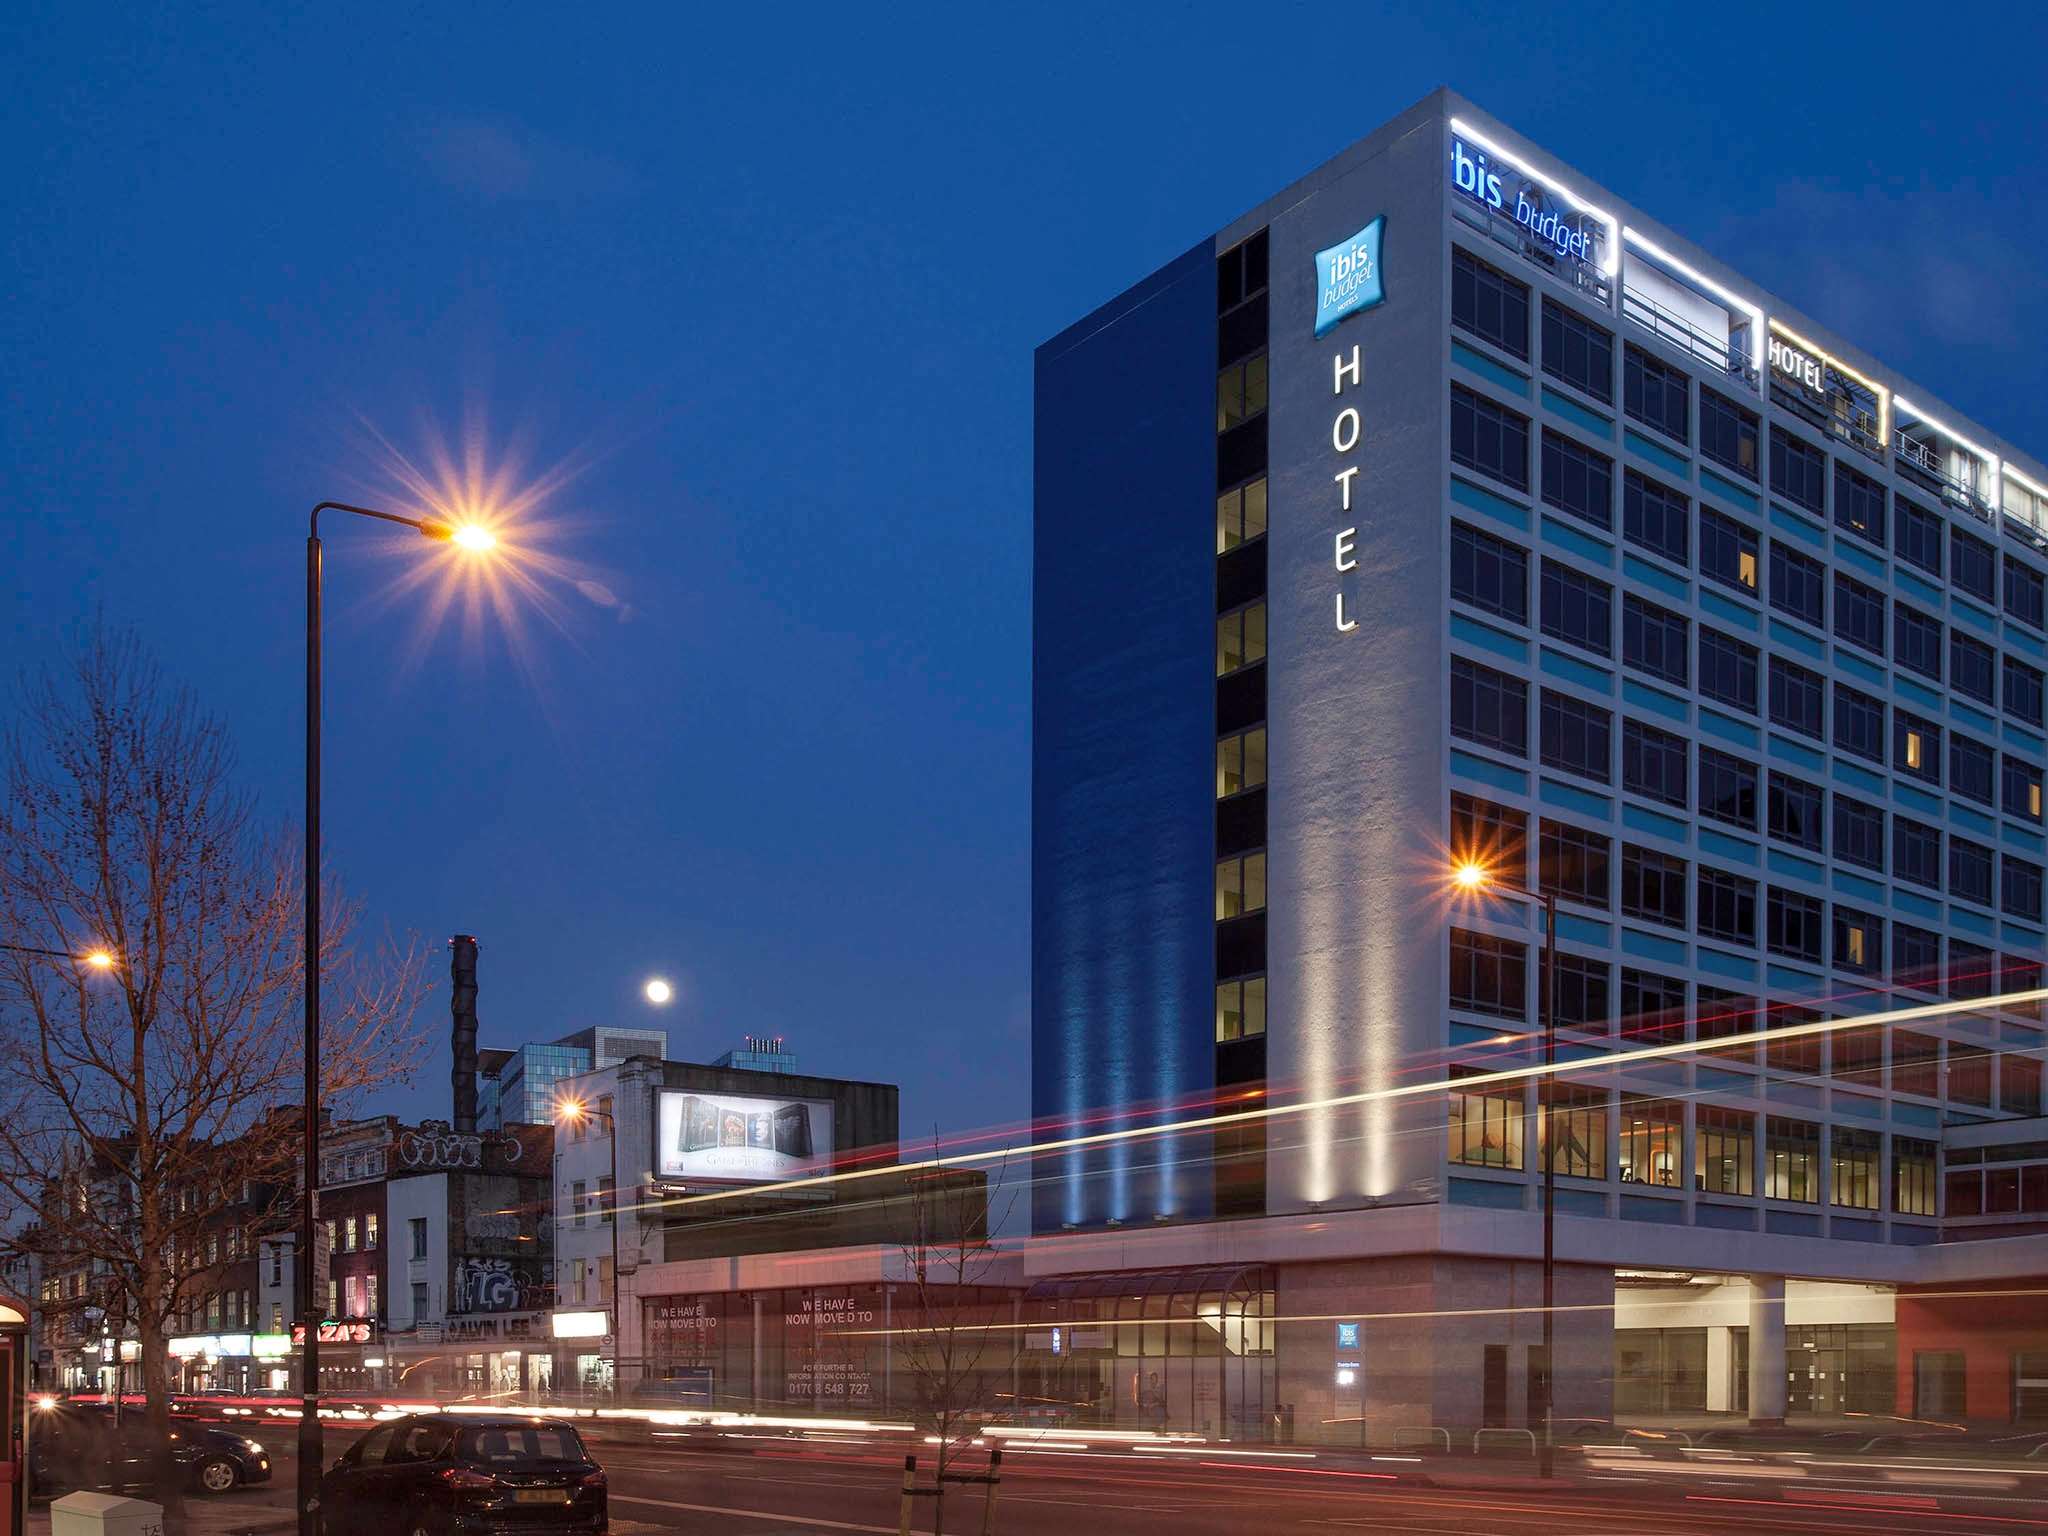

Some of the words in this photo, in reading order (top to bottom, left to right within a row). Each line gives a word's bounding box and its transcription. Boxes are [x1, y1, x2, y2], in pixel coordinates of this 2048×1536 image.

[1451, 141, 1502, 209] bis
[1517, 191, 1590, 260] budget
[1330, 241, 1368, 286] ibis
[1323, 260, 1374, 309] budget
[1769, 336, 1824, 393] HOTEL
[1333, 344, 1360, 633] HOTEL
[678, 1305, 703, 1318] HAVE
[803, 1300, 821, 1312] WE
[824, 1298, 855, 1311] HAVE
[670, 1318, 704, 1329] MOVED
[705, 1317, 717, 1328] TO
[785, 1313, 810, 1325] NOW
[814, 1312, 855, 1325] MOVED
[857, 1311, 873, 1323] TO
[293, 1323, 371, 1343] ZZA'S
[824, 1383, 844, 1394] 548
